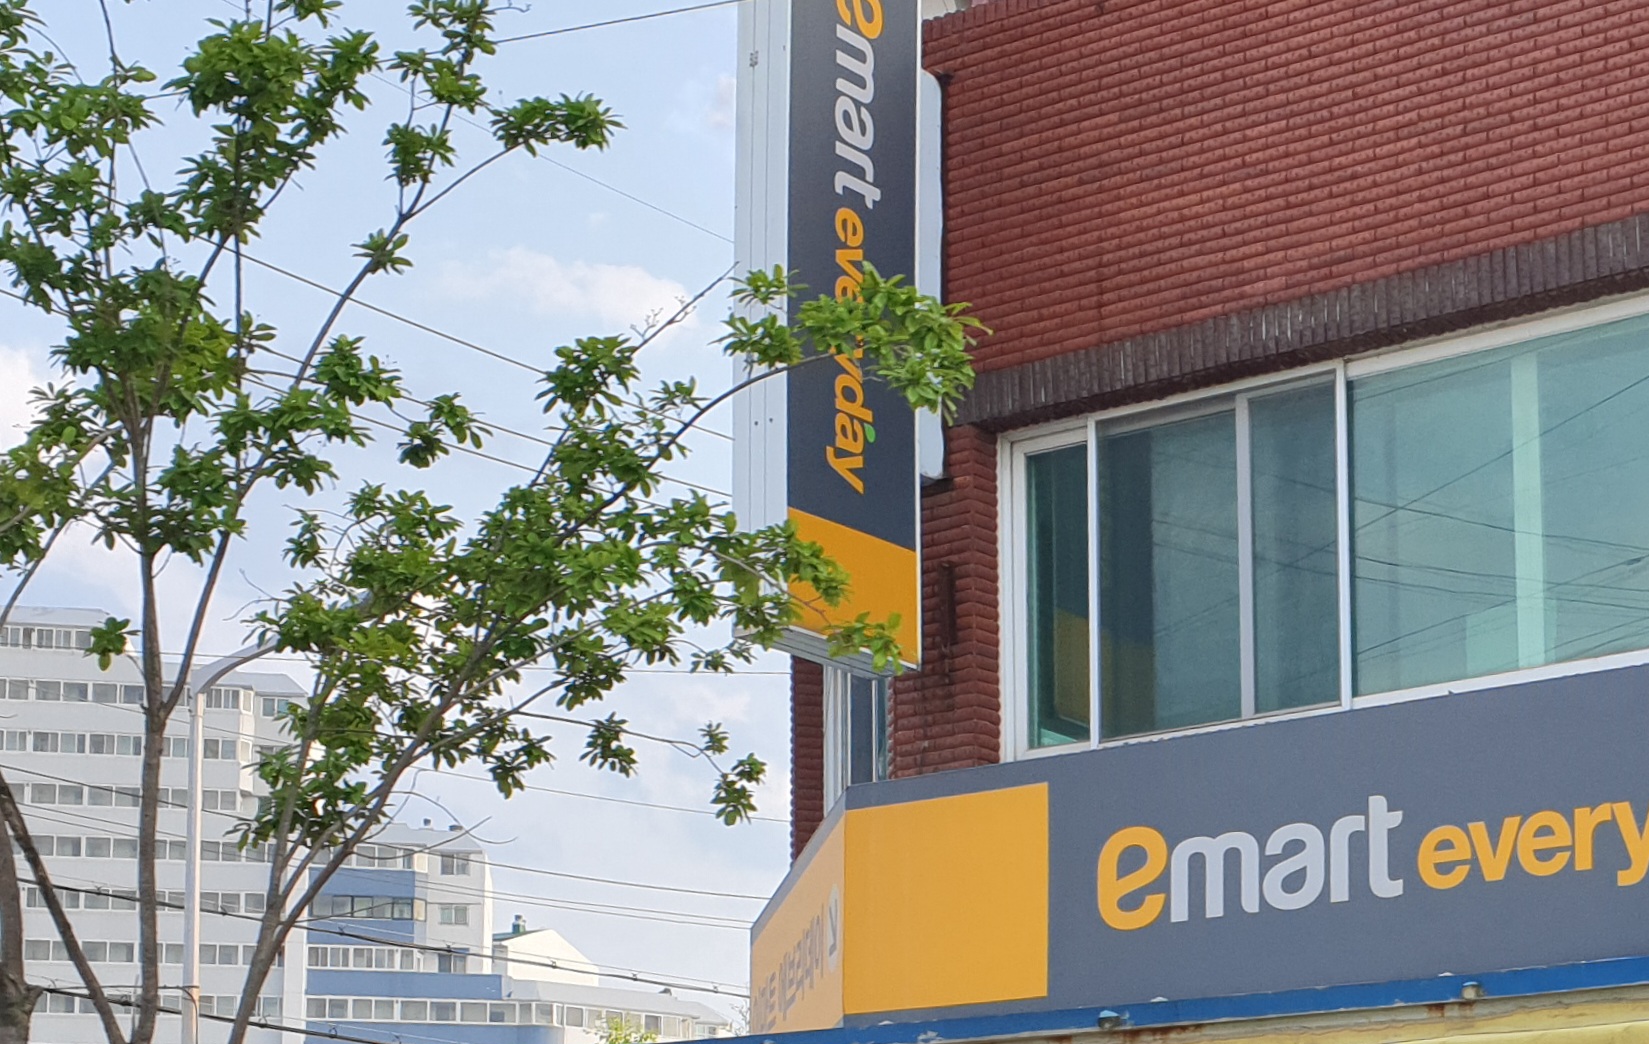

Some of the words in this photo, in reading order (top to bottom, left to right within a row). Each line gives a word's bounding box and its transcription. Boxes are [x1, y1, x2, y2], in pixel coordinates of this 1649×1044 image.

[834, 0, 882, 209] emart
[826, 207, 873, 494] eveyday
[1097, 794, 1404, 931] emart
